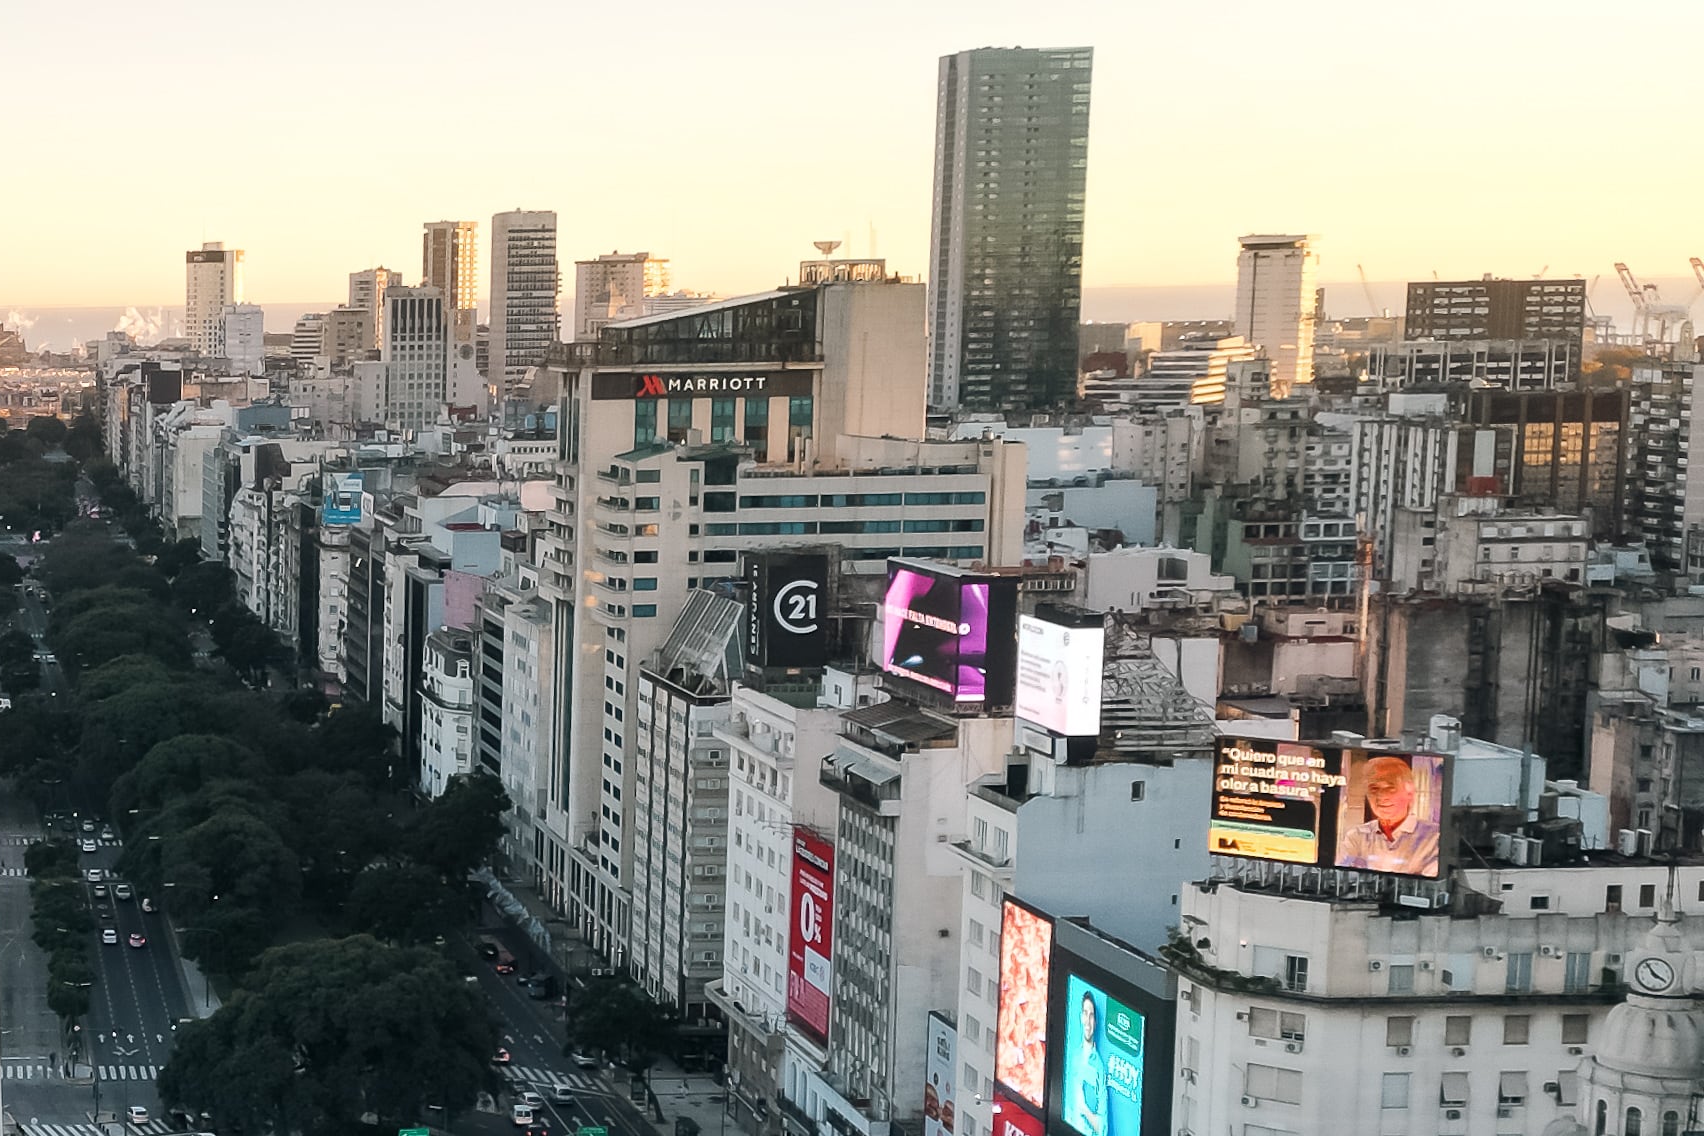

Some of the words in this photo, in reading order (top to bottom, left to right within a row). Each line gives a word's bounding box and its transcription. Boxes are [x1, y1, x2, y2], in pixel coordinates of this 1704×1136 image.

[668, 377, 766, 391] MARRIOTT
[1277, 754, 1305, 767] que
[1306, 757, 1326, 769] en
[1221, 763, 1239, 775] mi
[1240, 766, 1289, 781] cuadra
[1291, 771, 1310, 781] no
[1311, 771, 1347, 788] haya
[1220, 777, 1250, 791] olor
[1249, 782, 1259, 793] a
